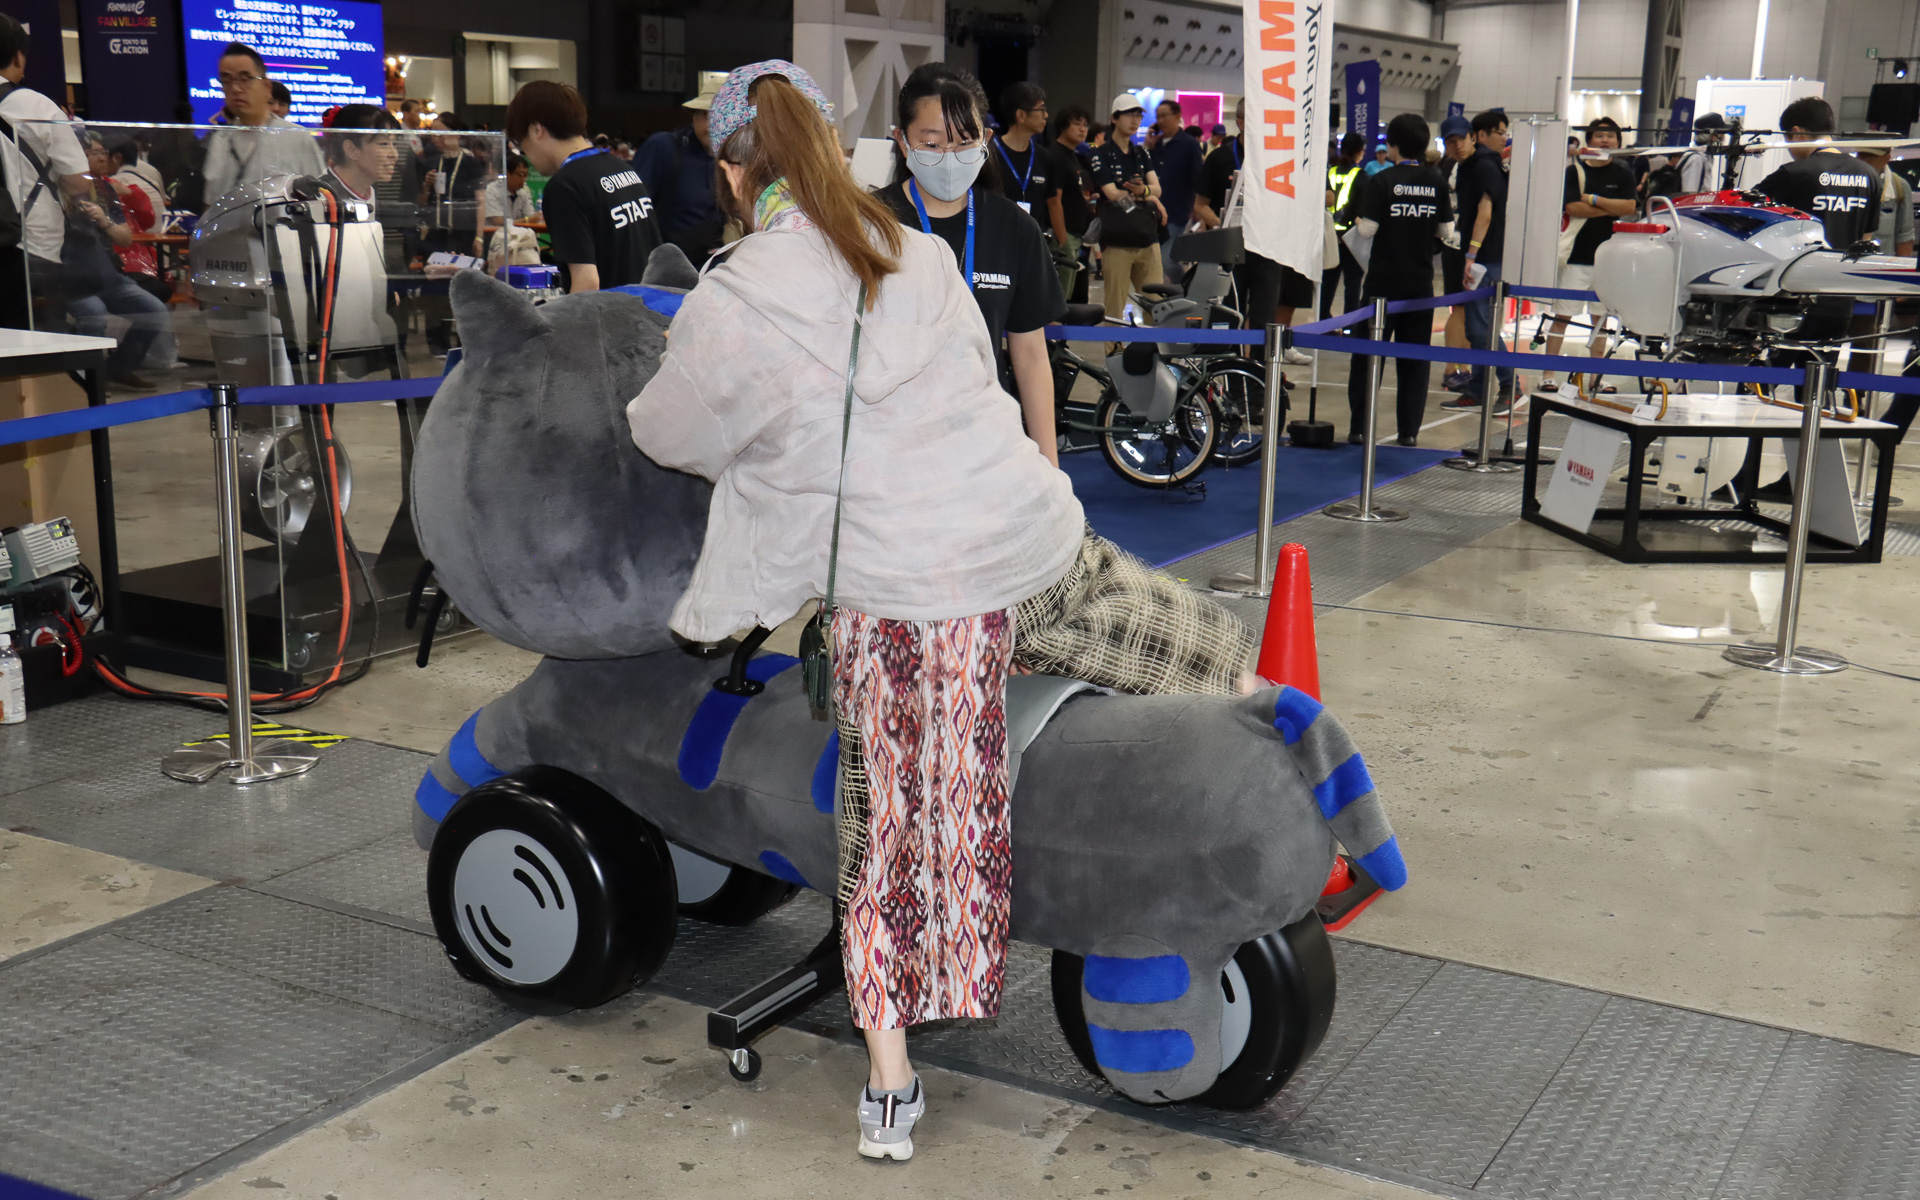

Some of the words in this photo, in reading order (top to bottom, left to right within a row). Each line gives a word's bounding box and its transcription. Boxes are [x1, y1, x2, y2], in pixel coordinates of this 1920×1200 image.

[97, 16, 118, 27] FAN
[118, 16, 157, 27] VILLAGE
[122, 46, 149, 54] ACTION
[1830, 173, 1868, 188] YAMAHA
[1403, 184, 1436, 197] YAMAHA
[610, 196, 653, 229] STAF
[1390, 203, 1437, 218] STAFF
[206, 259, 248, 273] HARMO
[980, 272, 1011, 285] YAMAHA
